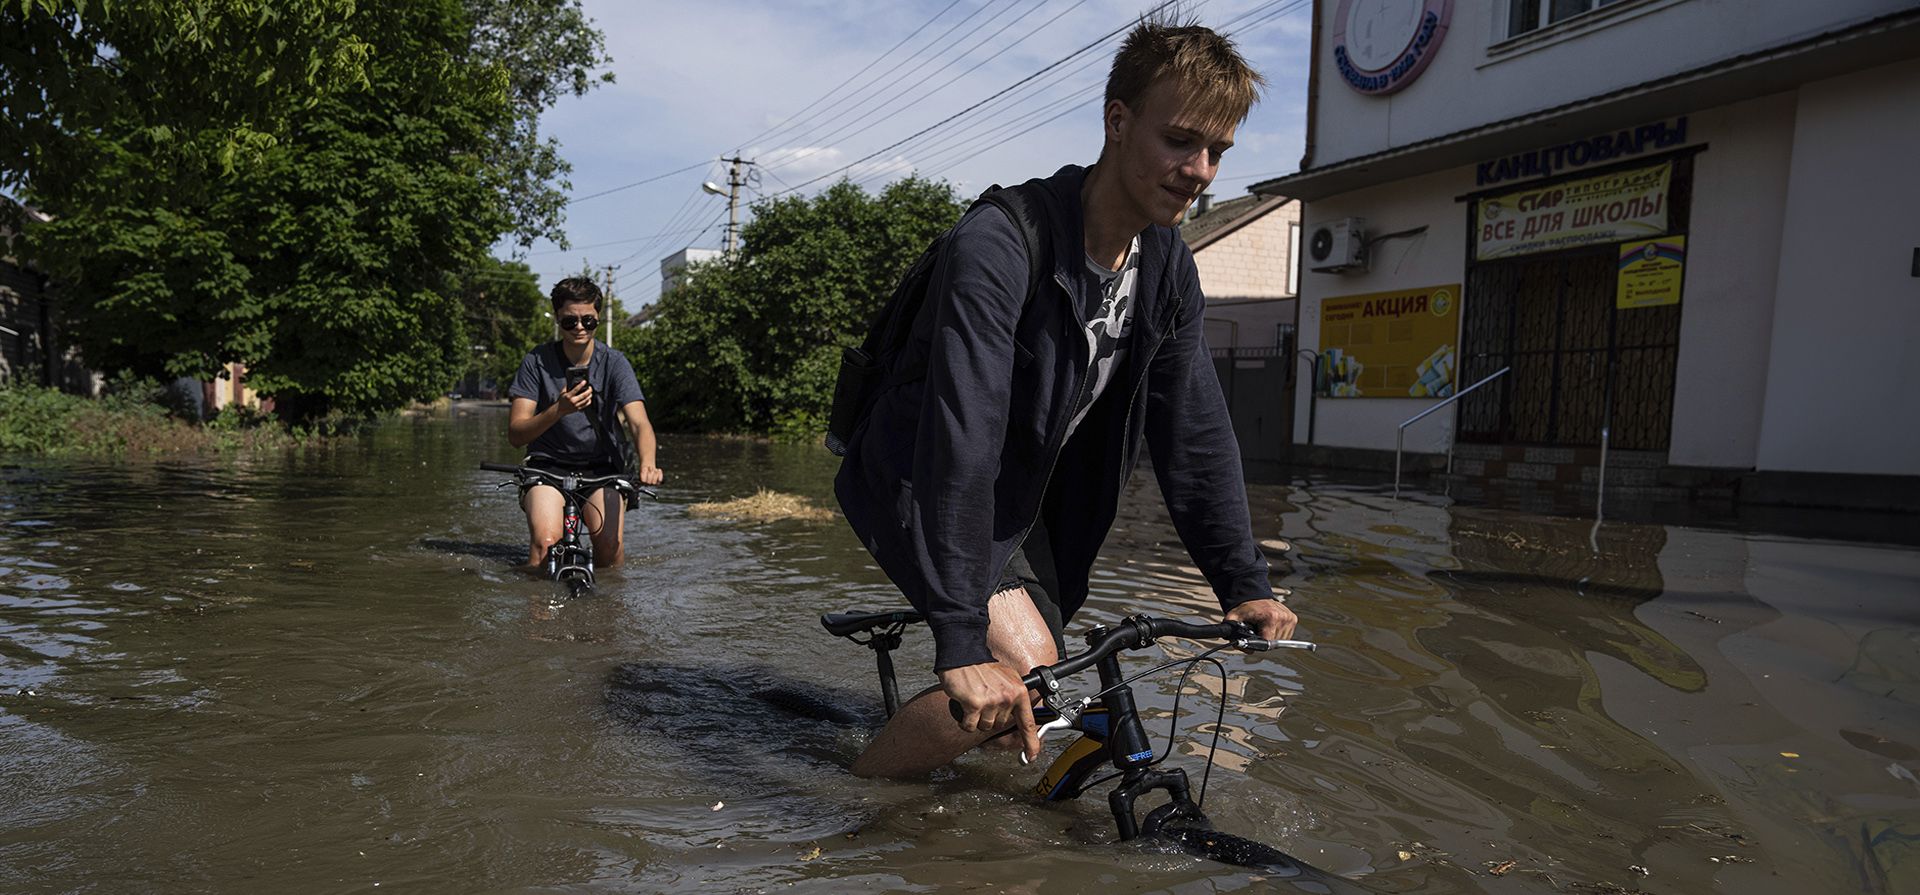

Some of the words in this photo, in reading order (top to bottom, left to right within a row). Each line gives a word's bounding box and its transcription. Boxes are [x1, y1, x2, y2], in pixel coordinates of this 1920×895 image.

[1379, 70, 1388, 88] В
[1413, 11, 1437, 56] ГОДУ
[1476, 116, 1687, 186] КАНЦТОВАРЫ
[1482, 219, 1516, 242] ВСЕ
[1521, 212, 1565, 241] ДЛЯ
[1571, 192, 1663, 229] ШКОЛЫ
[1518, 190, 1564, 212] СТАР
[1362, 295, 1428, 318] АКЦИЯ
